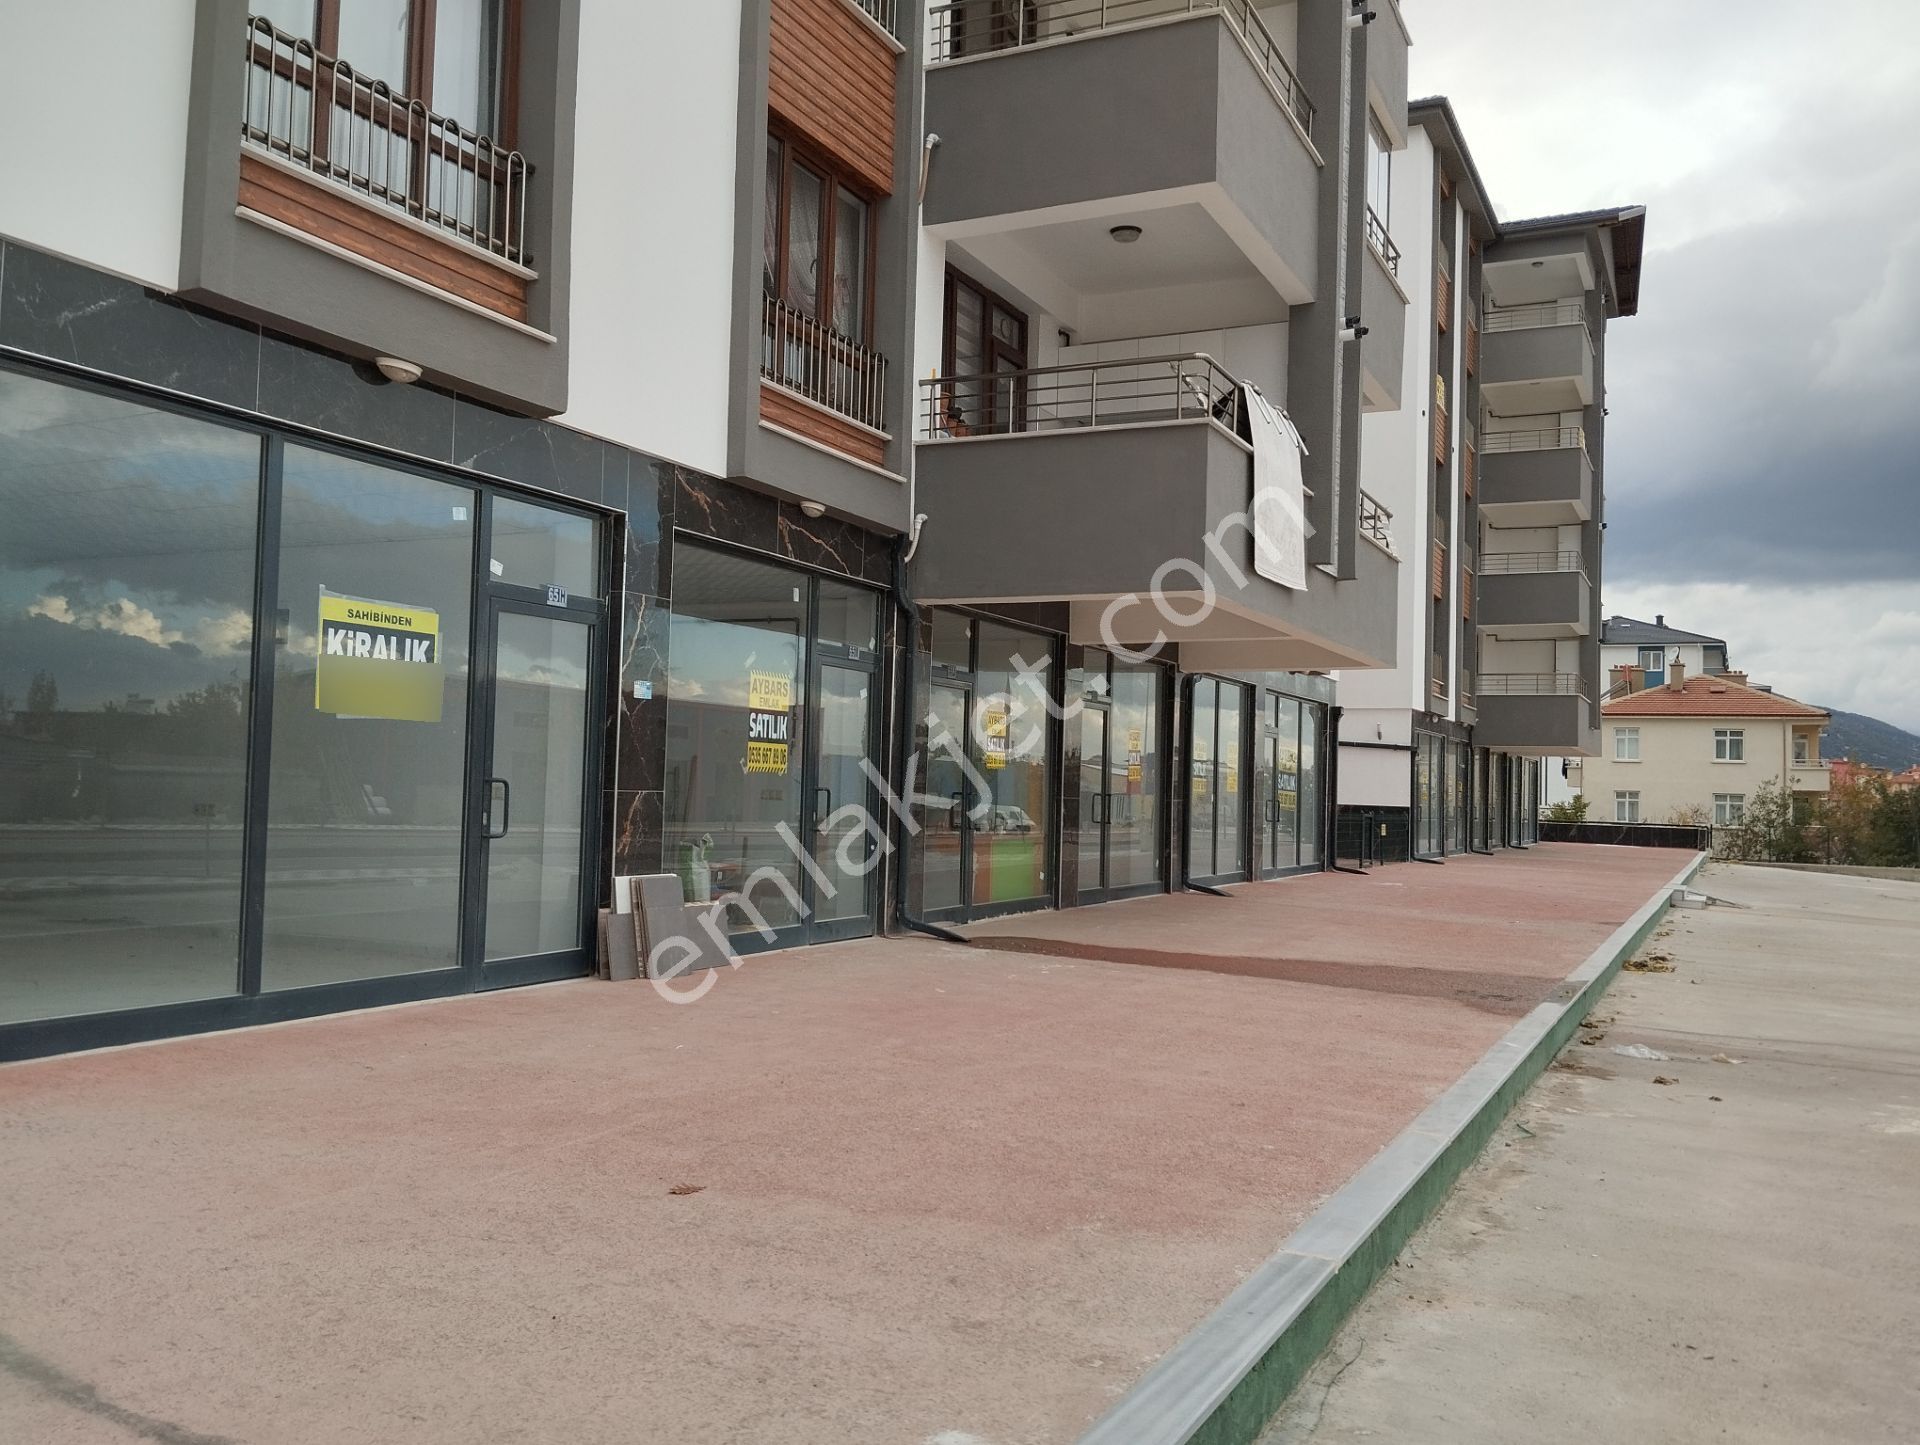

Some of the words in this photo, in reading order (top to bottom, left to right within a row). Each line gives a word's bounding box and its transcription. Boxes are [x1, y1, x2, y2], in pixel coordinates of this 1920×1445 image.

[347, 608, 412, 627] SAHİBİNDEN
[751, 678, 789, 697] AYBARS
[759, 696, 780, 709] EMLAK
[749, 712, 788, 740] SATILIK
